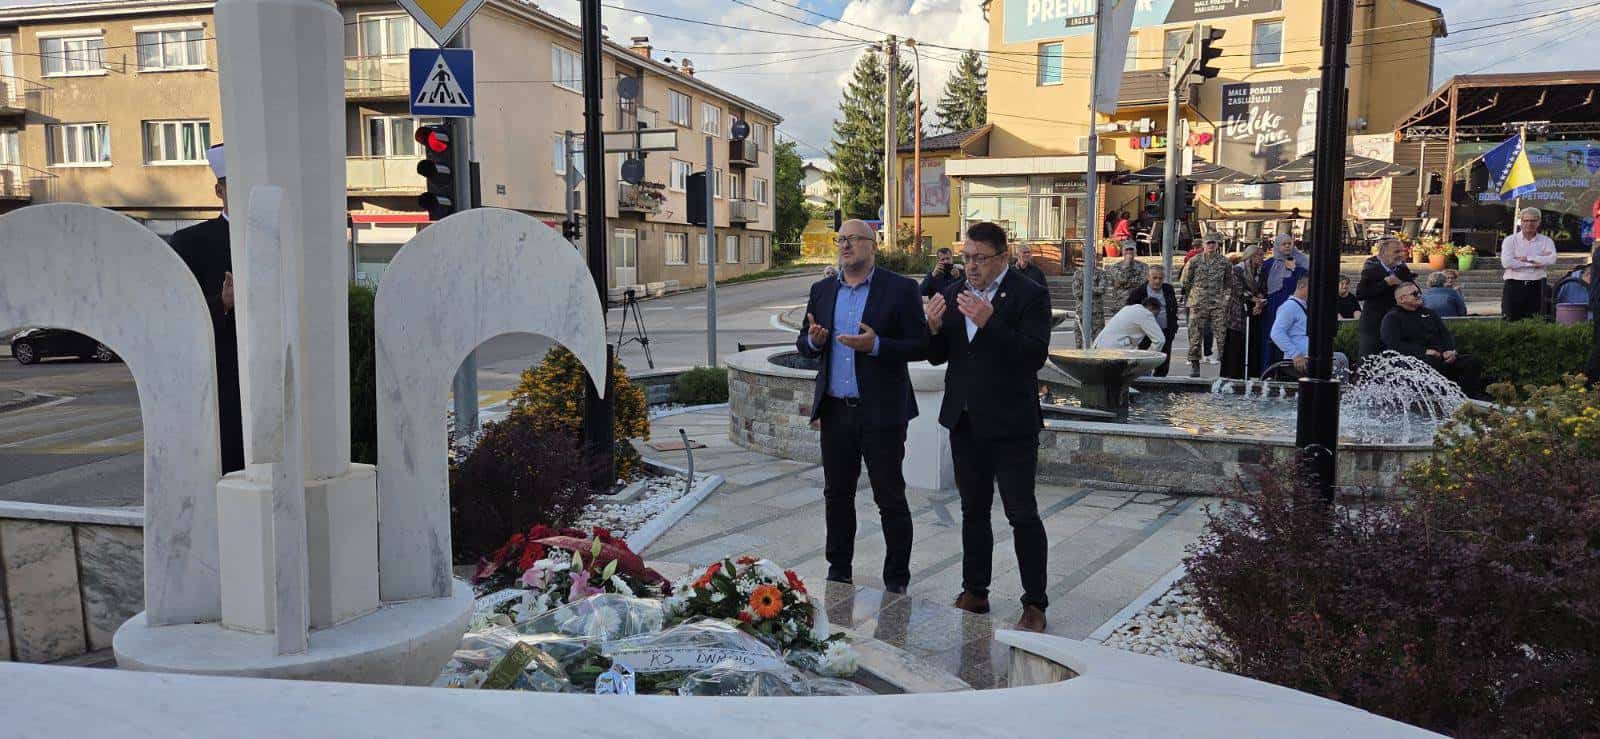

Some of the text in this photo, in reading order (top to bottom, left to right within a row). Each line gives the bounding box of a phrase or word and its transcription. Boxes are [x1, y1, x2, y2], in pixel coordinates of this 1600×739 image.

[1227, 86, 1284, 97] MALE POBJEDE
[1226, 105, 1283, 138] Veliko
